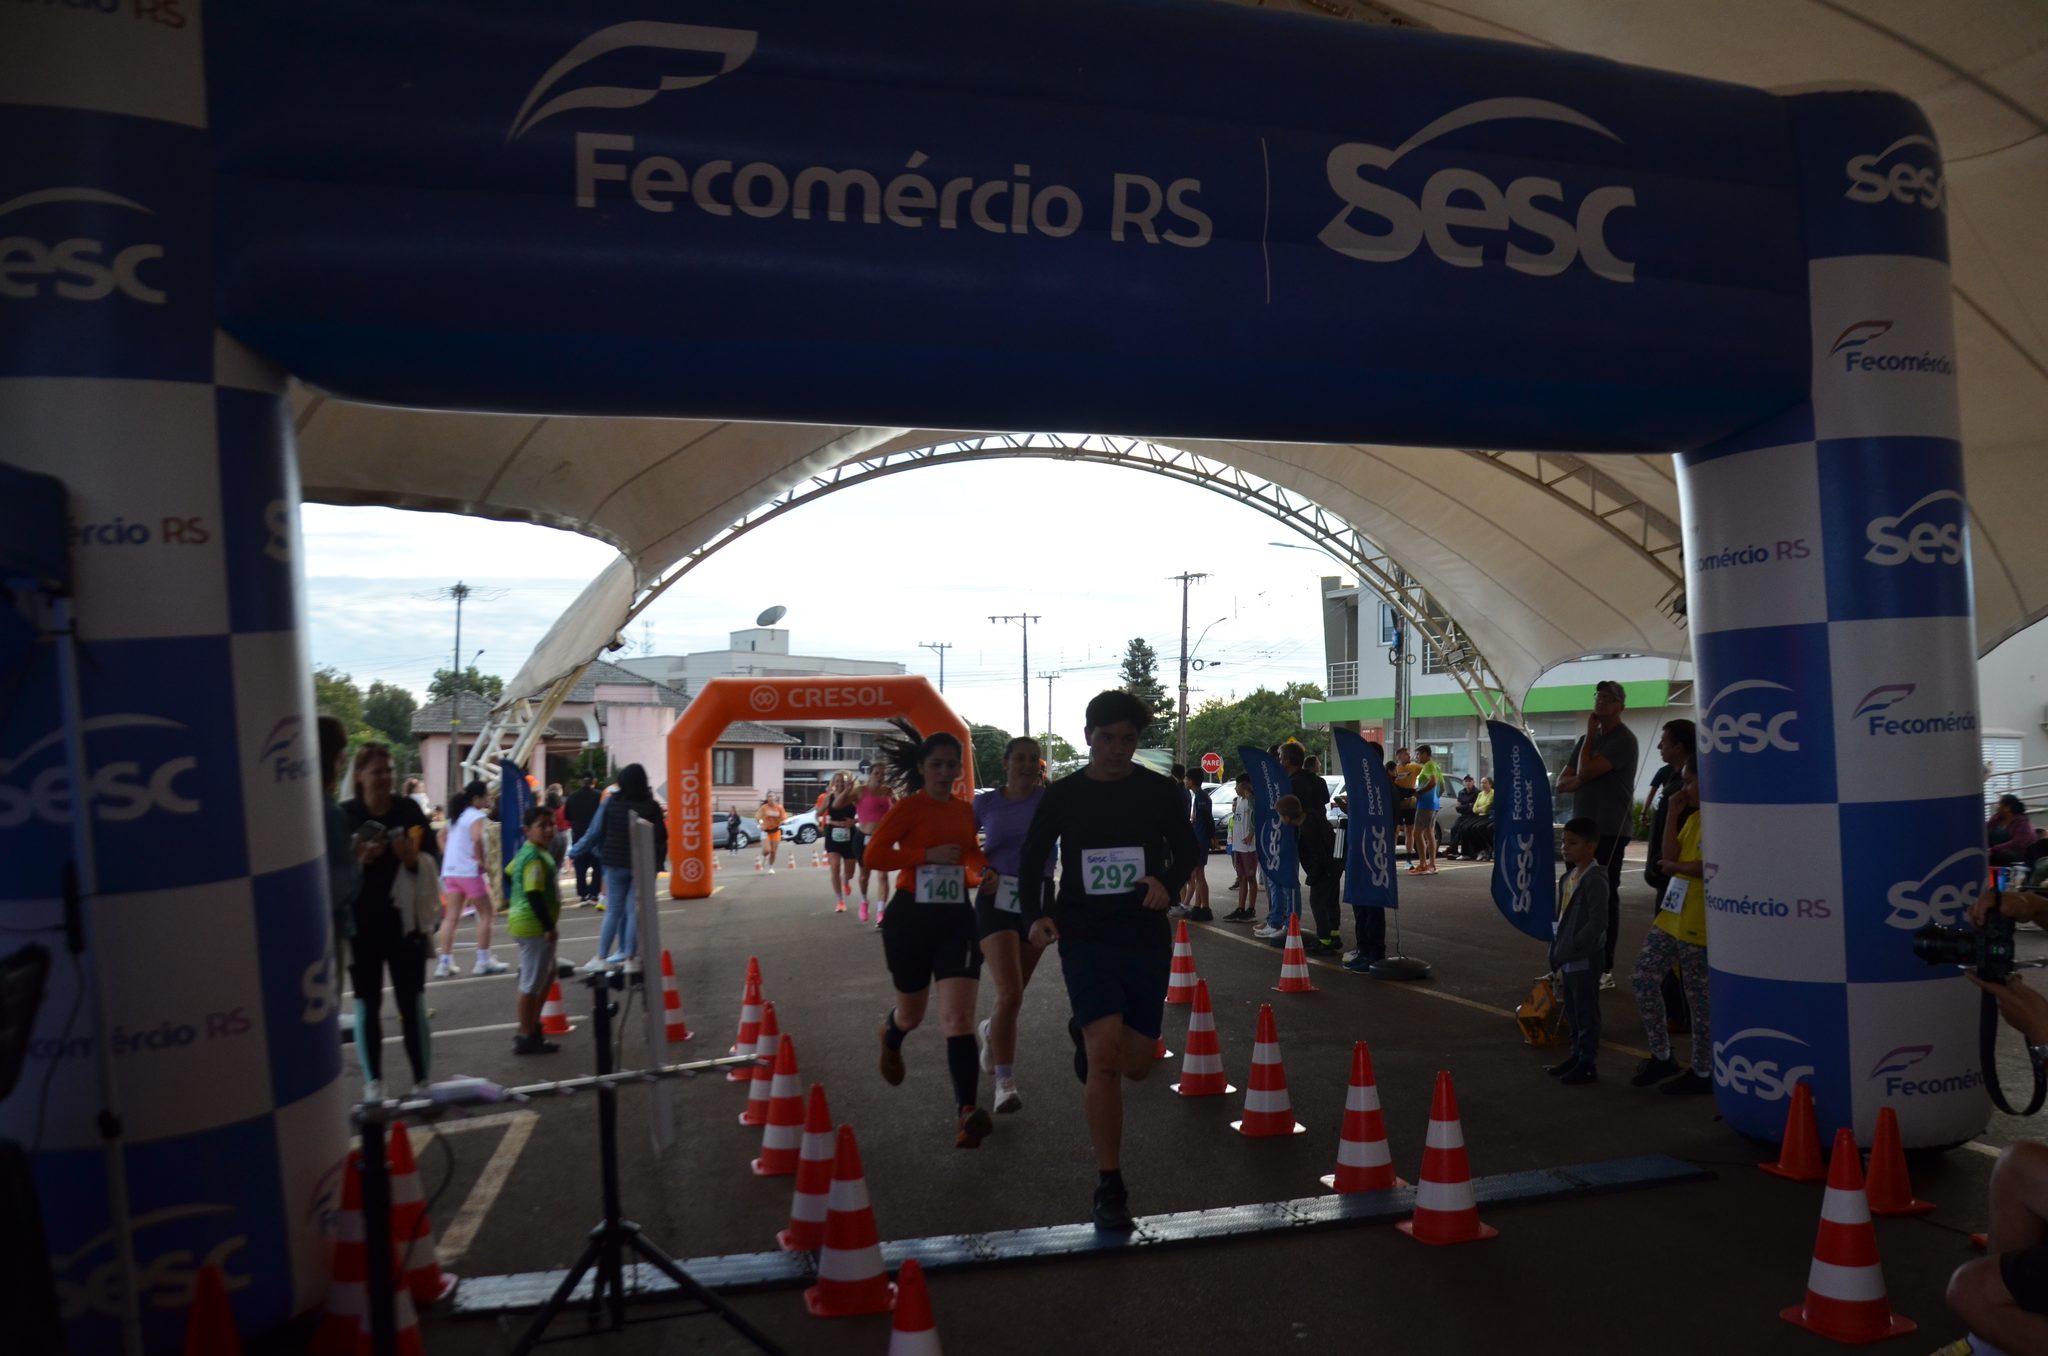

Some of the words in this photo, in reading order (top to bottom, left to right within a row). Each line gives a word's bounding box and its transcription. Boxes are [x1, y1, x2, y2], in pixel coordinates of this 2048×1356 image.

[576, 130, 1084, 238] Fecomércio
[1110, 172, 1214, 248] RS
[1844, 152, 1941, 210] Ses
[1317, 140, 1637, 284] Sesc
[0, 236, 169, 304] esc
[160, 515, 210, 545] RS
[1864, 515, 1966, 565] Ses
[1697, 544, 1769, 572] omércio
[1776, 539, 1810, 561] RS
[787, 686, 894, 708] CRESOL
[1869, 710, 1976, 736] Fecomérci
[1202, 759, 1220, 767] PARE
[1361, 757, 1376, 816] Fecomércio
[1510, 745, 1523, 821] Fecomércio
[681, 762, 700, 851] CRESOL
[1090, 863, 1137, 889] 292
[1371, 825, 1390, 889] Sesc
[1512, 833, 1535, 914] Sesc
[924, 879, 959, 900] 140
[1705, 892, 1789, 917] ecomércio
[1797, 899, 1832, 919] RS
[1883, 880, 1988, 930] Ses
[206, 1007, 252, 1040] RS
[1887, 1068, 1985, 1097] Fecomér
